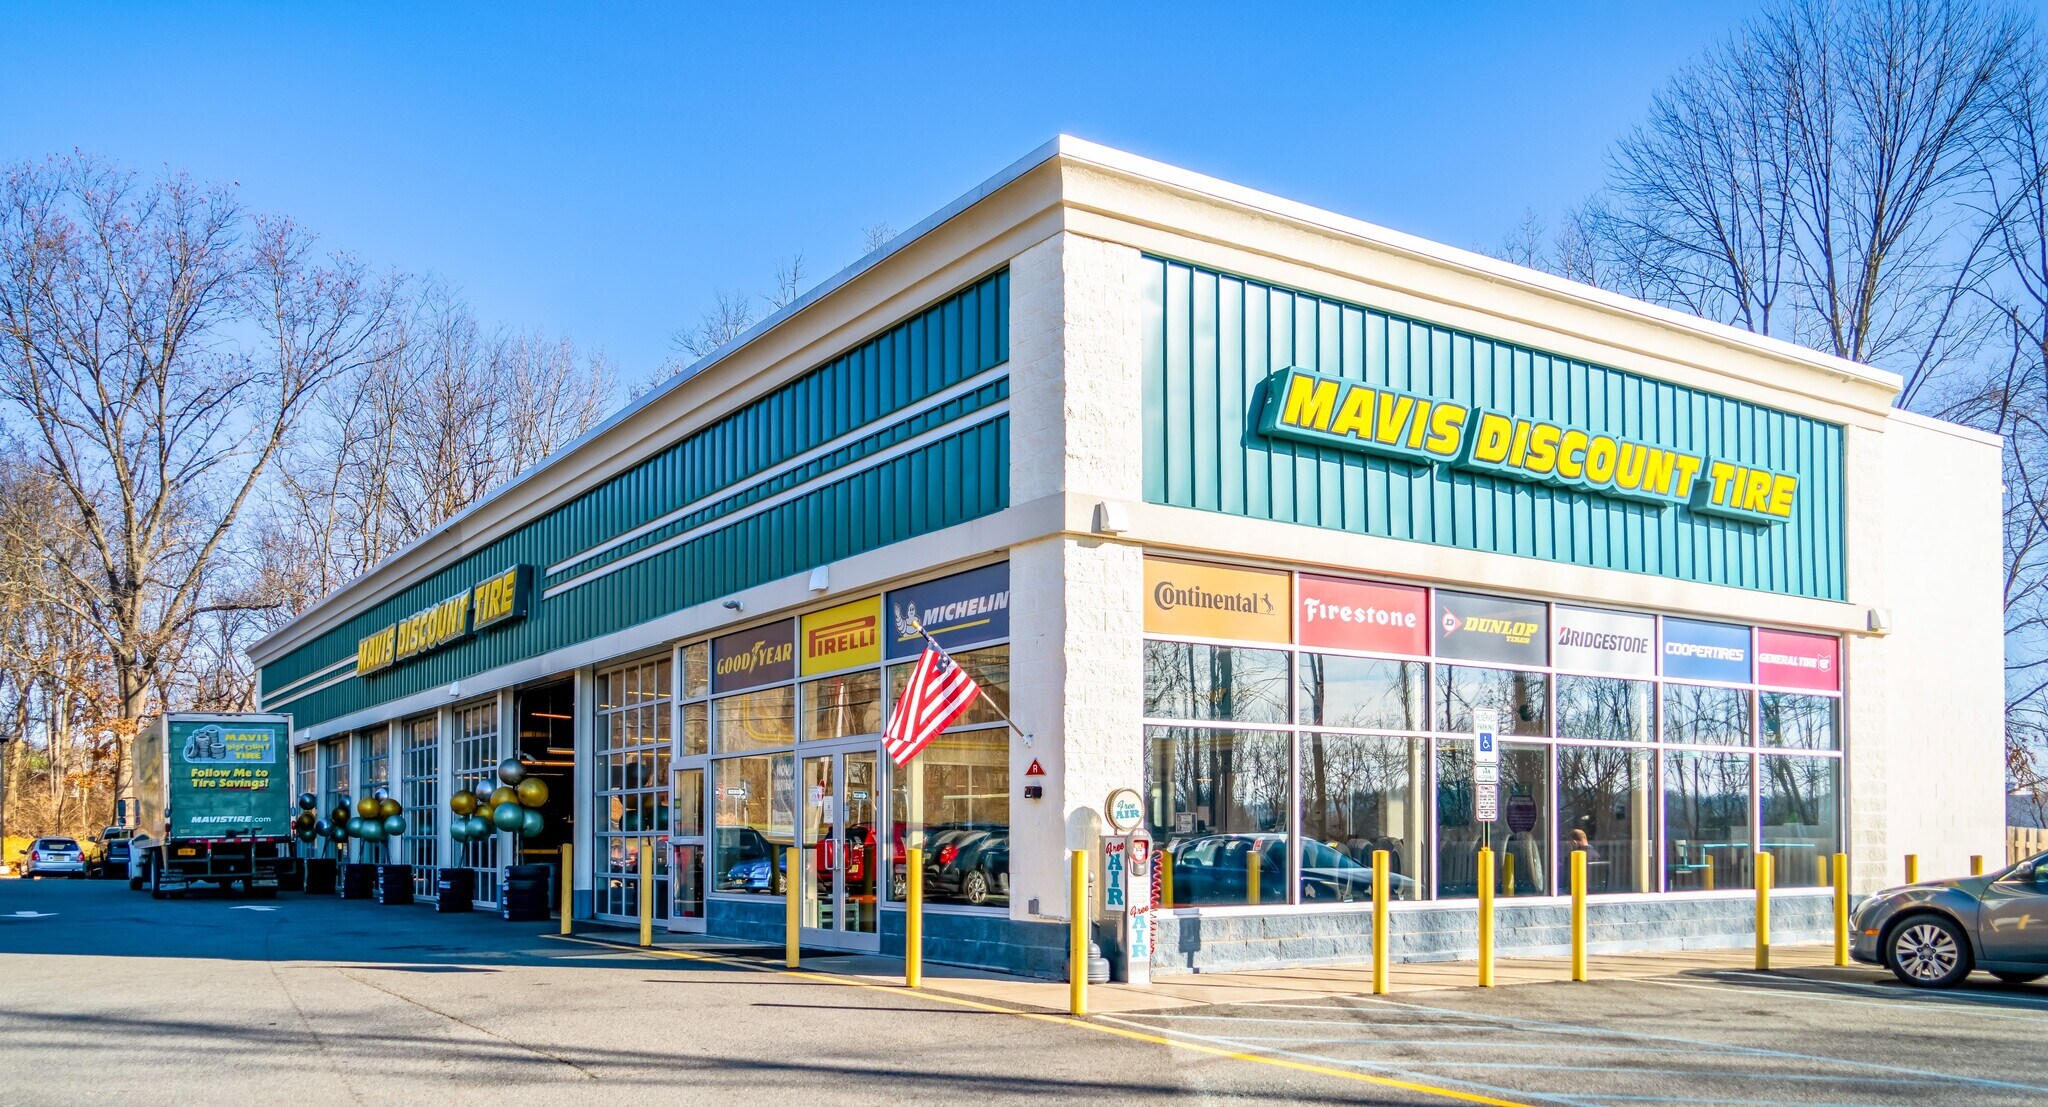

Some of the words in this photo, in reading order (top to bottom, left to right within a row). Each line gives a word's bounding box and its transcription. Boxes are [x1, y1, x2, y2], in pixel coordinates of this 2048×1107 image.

[1283, 373, 1467, 456] MAVIS
[1473, 412, 1702, 498] DISCOUNT
[1710, 461, 1798, 518] TIRE
[1153, 580, 1259, 615] Continental
[922, 590, 1010, 626] MICHELIN
[1304, 597, 1417, 628] Firestone
[357, 630, 395, 673] MAVIS
[396, 593, 470, 656] DISCOUNT
[474, 571, 516, 624] TIRE
[1463, 616, 1538, 637] DUNLOP
[808, 615, 876, 658] PIRELLI
[1506, 635, 1531, 644] TIRES
[1558, 626, 1649, 654] BRIDGESTONE
[716, 640, 793, 675] GOODYEAR
[1759, 652, 1798, 666] GENERAL
[1798, 656, 1818, 668] TIRE
[225, 733, 270, 742] MAVIS
[234, 752, 262, 760] TIRE
[190, 768, 230, 778] Follow
[233, 768, 252, 778] Me
[256, 768, 269, 777] to
[1032, 764, 1038, 774] R
[191, 779, 216, 788] Tire
[218, 779, 269, 791] Savings!
[1117, 799, 1135, 811] Free
[191, 815, 272, 823] MAVISTIRE.com
[1115, 809, 1140, 820] AIR
[1105, 842, 1125, 856] Free
[1107, 853, 1123, 905] AIR
[1130, 905, 1149, 917] Free
[1131, 916, 1148, 959] AIR
